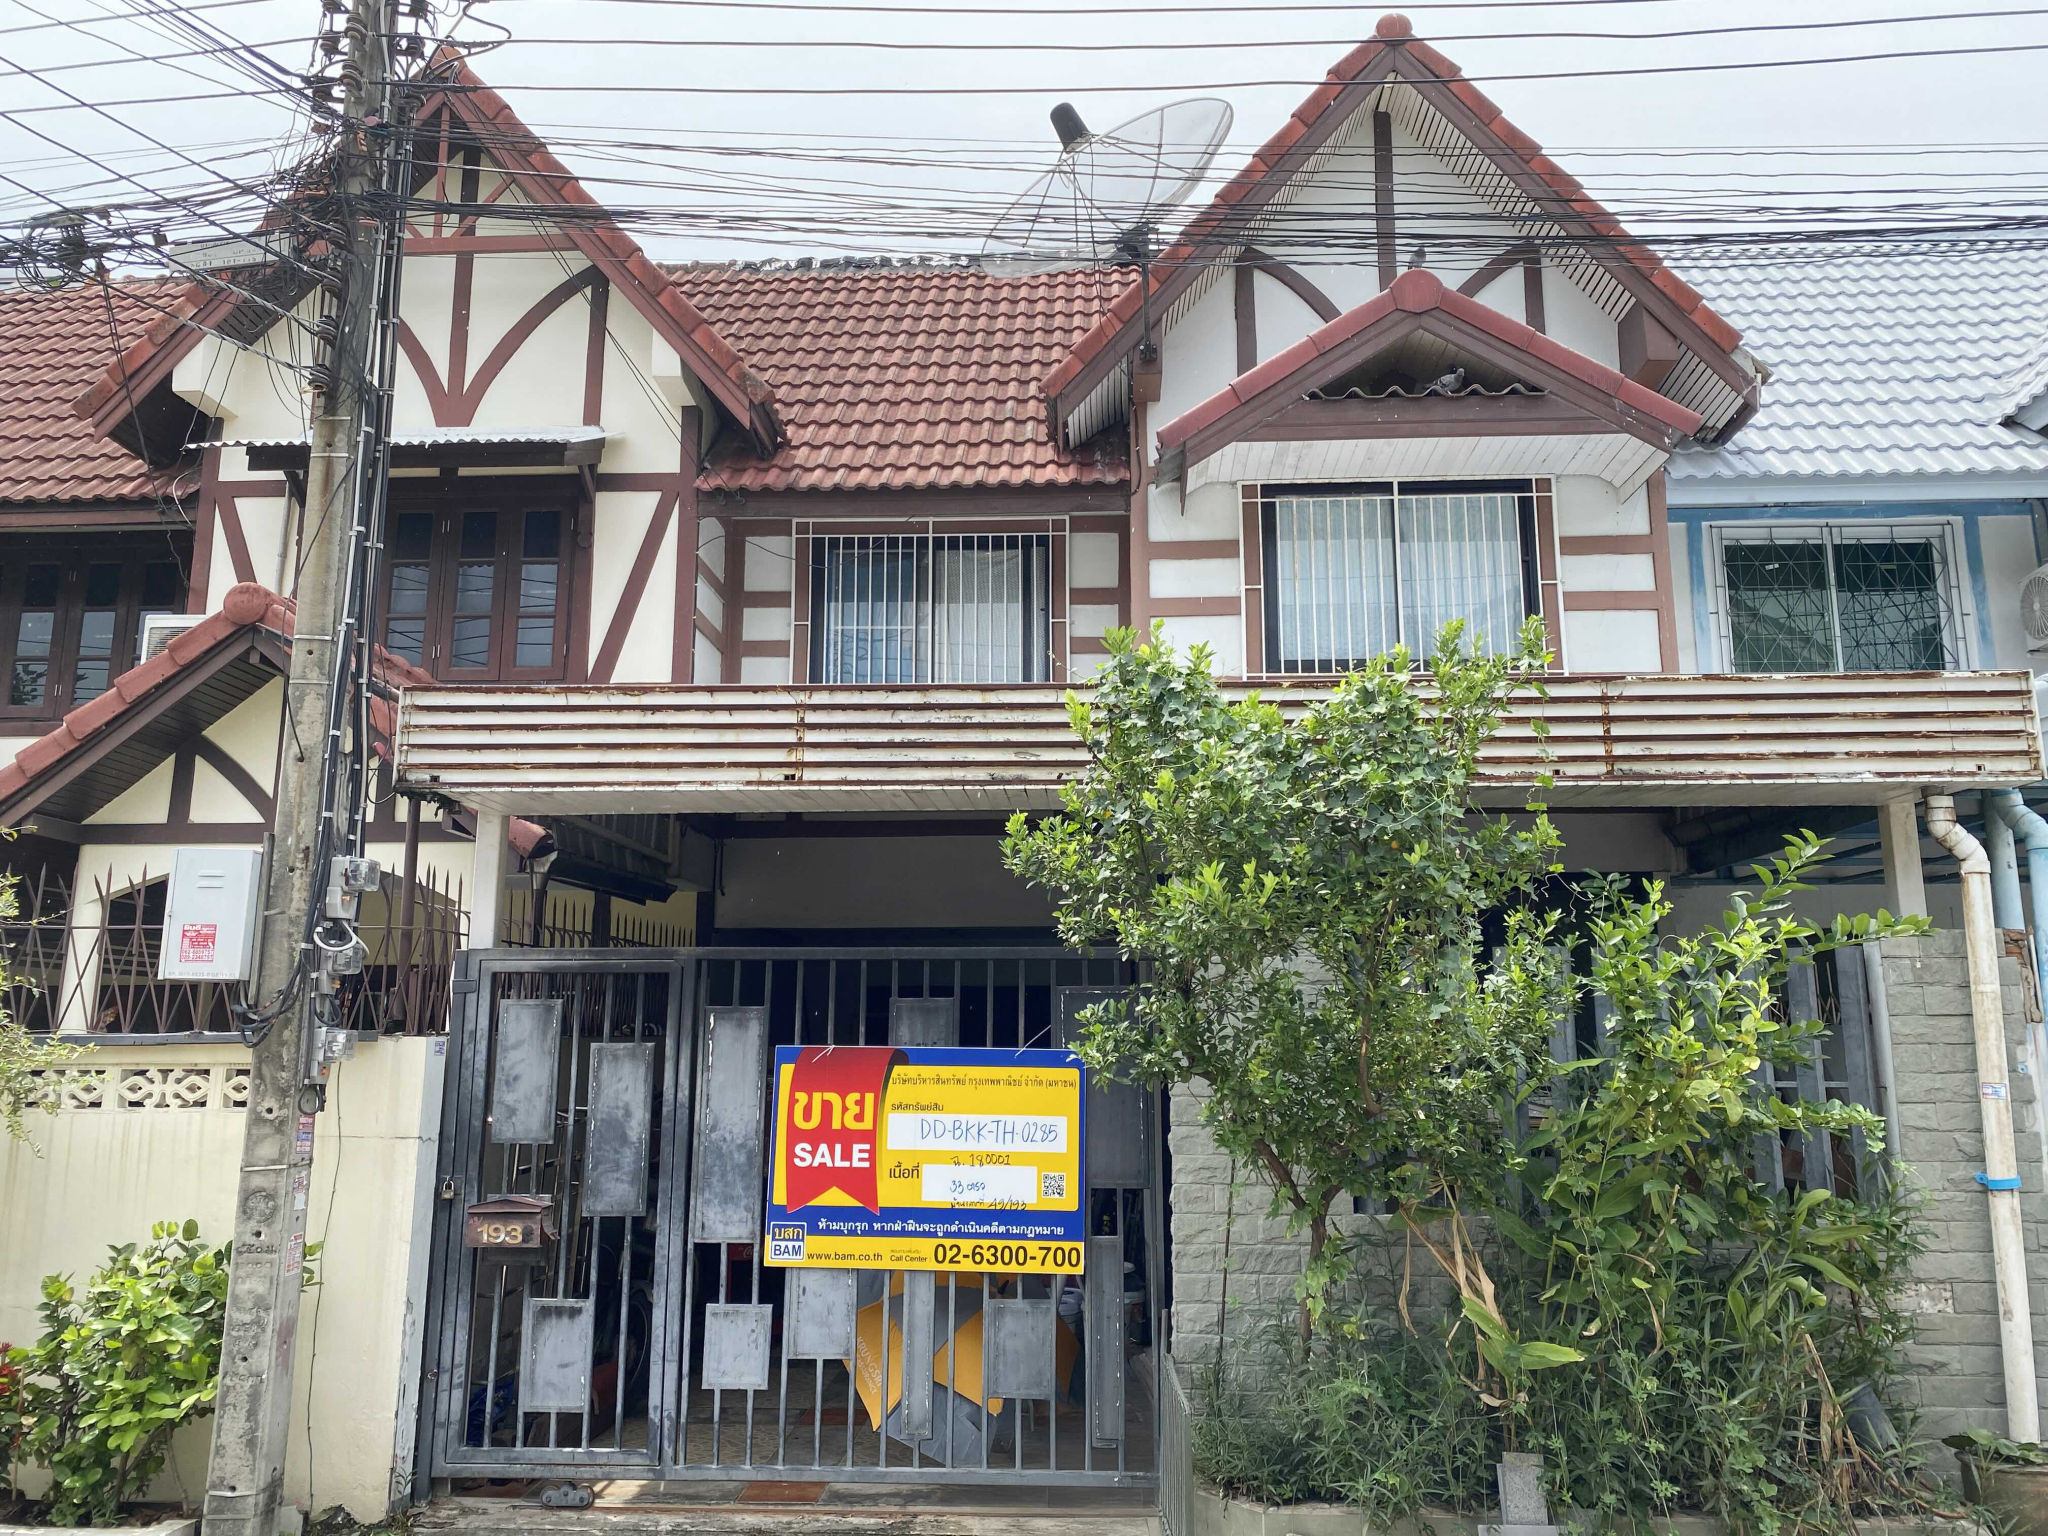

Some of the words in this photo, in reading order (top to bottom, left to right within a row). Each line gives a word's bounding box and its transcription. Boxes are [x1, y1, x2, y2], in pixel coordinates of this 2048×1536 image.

[1025, 1075, 1044, 1087] จำกัด
[1046, 1078, 1077, 1090] (มหาชน)
[794, 1091, 875, 1130] ขาย
[793, 1142, 871, 1168] SALE
[889, 1161, 920, 1179] เนื้อที่
[774, 1227, 803, 1240] บสก
[818, 1218, 869, 1235] ห้ามบุกรุก
[773, 1244, 802, 1257] BAM
[807, 1252, 883, 1262] www.bam.co.th
[934, 1244, 1081, 1268] 02-6300-700
[904, 1255, 928, 1263] Center
